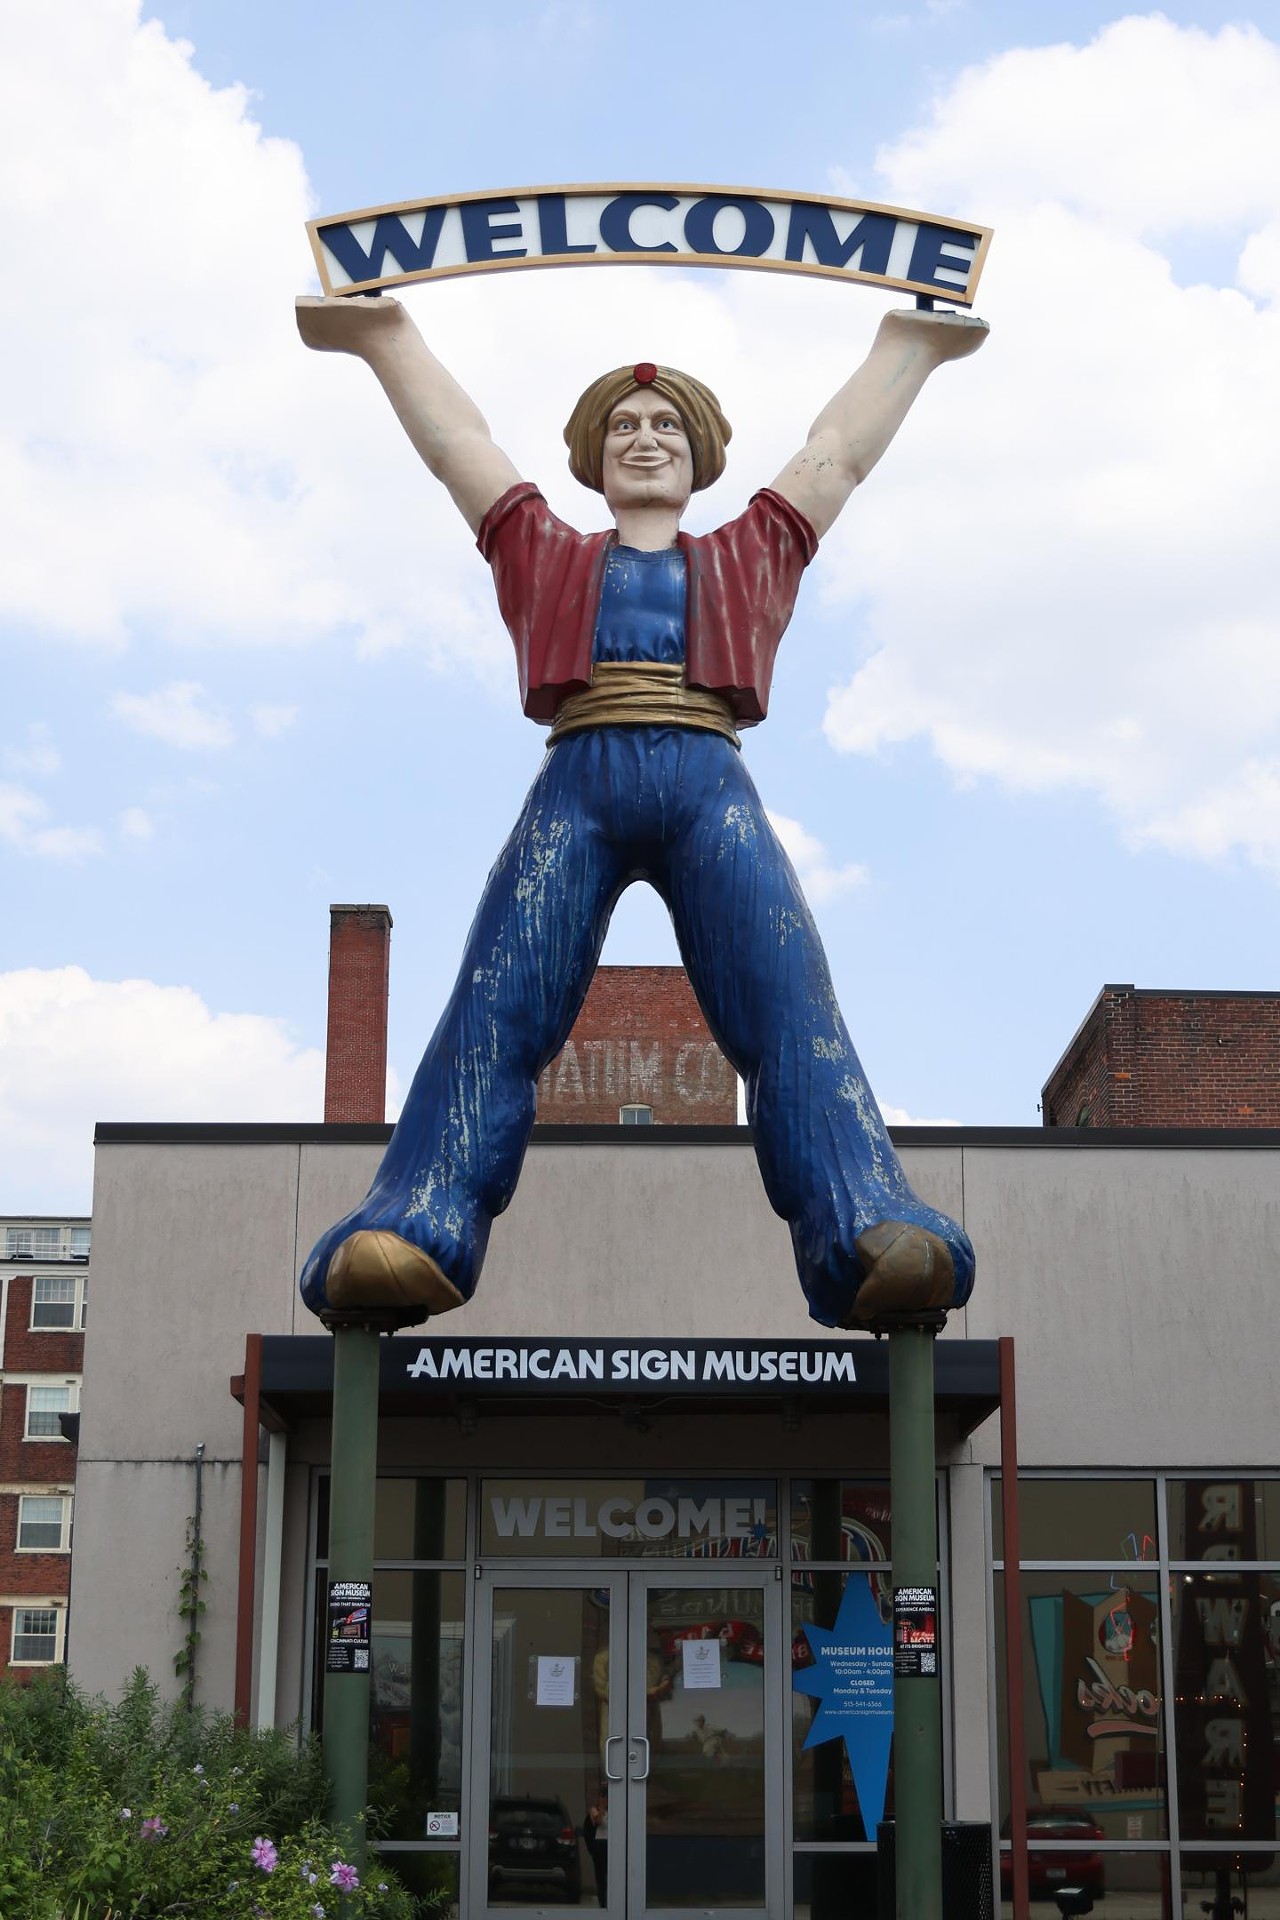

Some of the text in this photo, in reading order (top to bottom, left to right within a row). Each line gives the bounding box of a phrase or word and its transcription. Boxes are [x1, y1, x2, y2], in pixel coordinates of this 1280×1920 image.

[318, 193, 975, 293] WELCOME
[406, 1348, 857, 1382] AMERICAN SIGN MUSEUM
[490, 1498, 766, 1538] WELCOME!
[820, 1647, 866, 1655] MUSEUM
